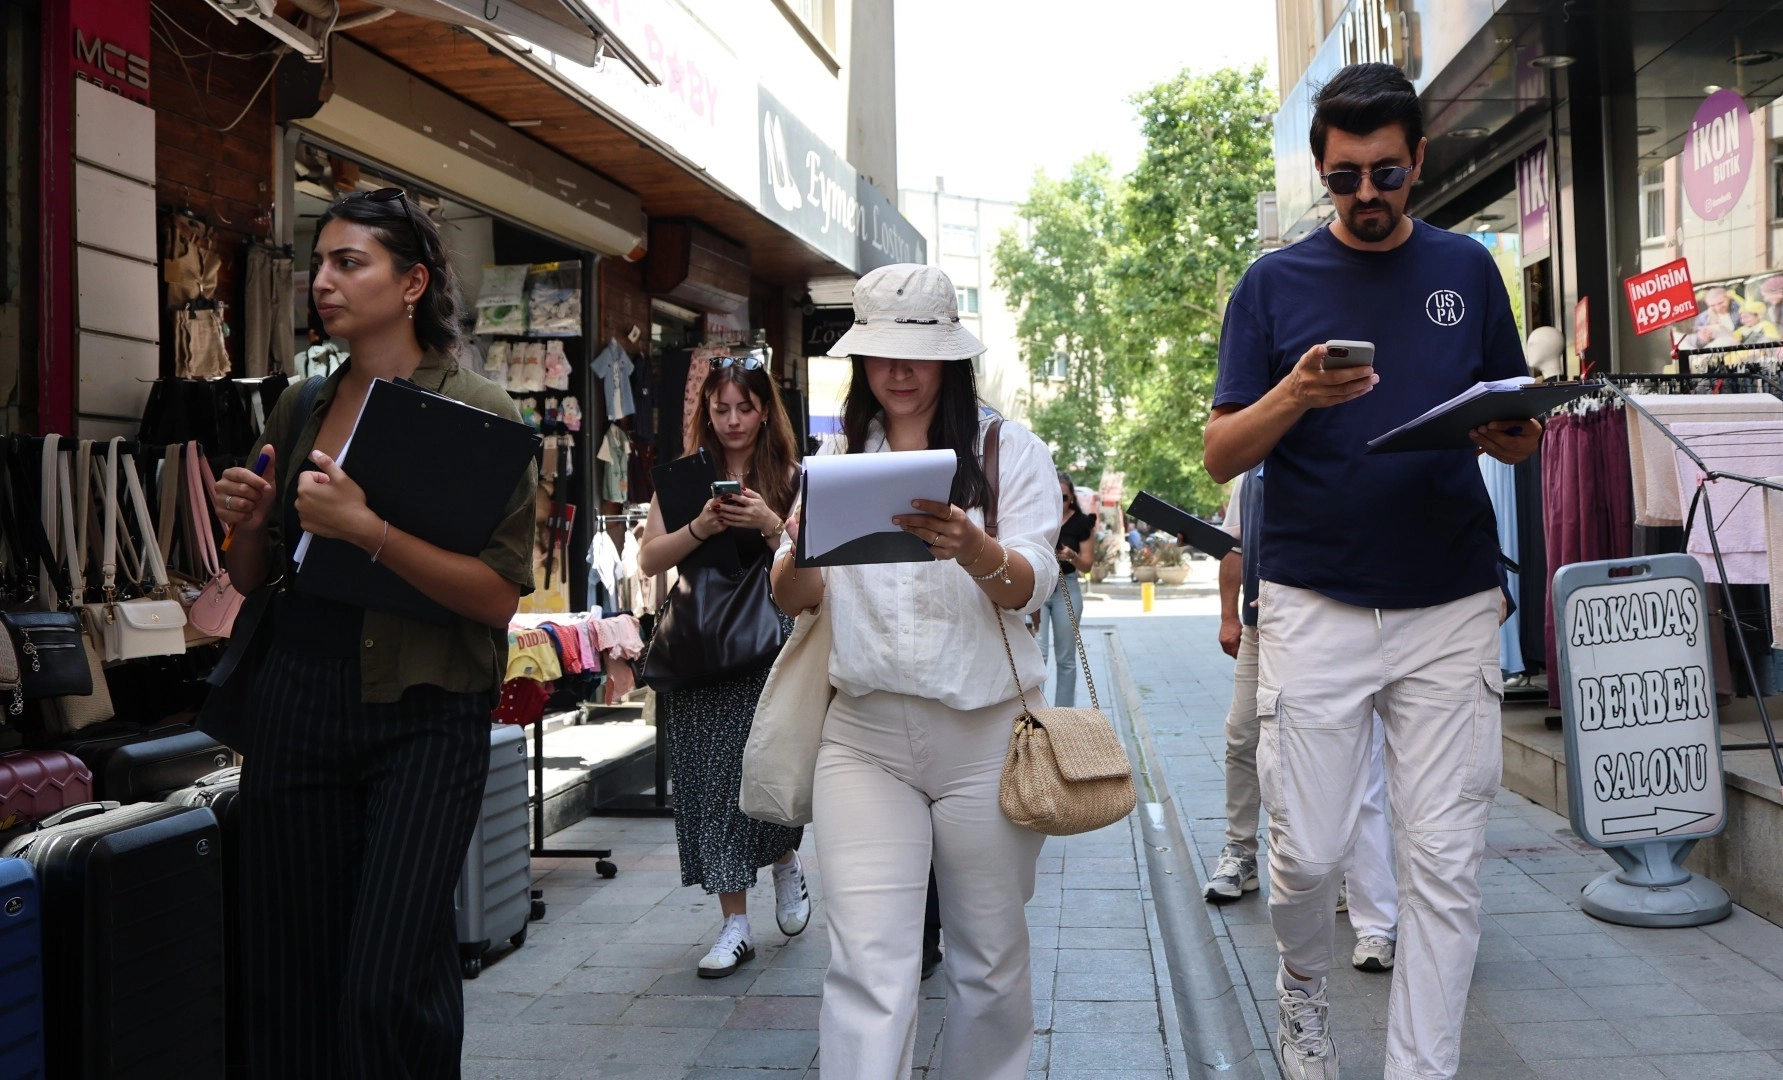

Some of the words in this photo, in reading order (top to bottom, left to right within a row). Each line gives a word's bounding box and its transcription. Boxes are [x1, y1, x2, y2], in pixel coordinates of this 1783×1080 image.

[76, 28, 149, 90] MCS
[1692, 106, 1740, 172] İKON
[1713, 152, 1740, 185] BUTİK
[805, 150, 868, 241] Eymen
[1435, 293, 1455, 308] US
[1630, 266, 1689, 301] İNDİRİM
[1437, 307, 1457, 323] PA
[1571, 587, 1698, 647] ARKADAŞ
[1578, 665, 1709, 731] BERBER
[1594, 744, 1707, 802] SALONU
